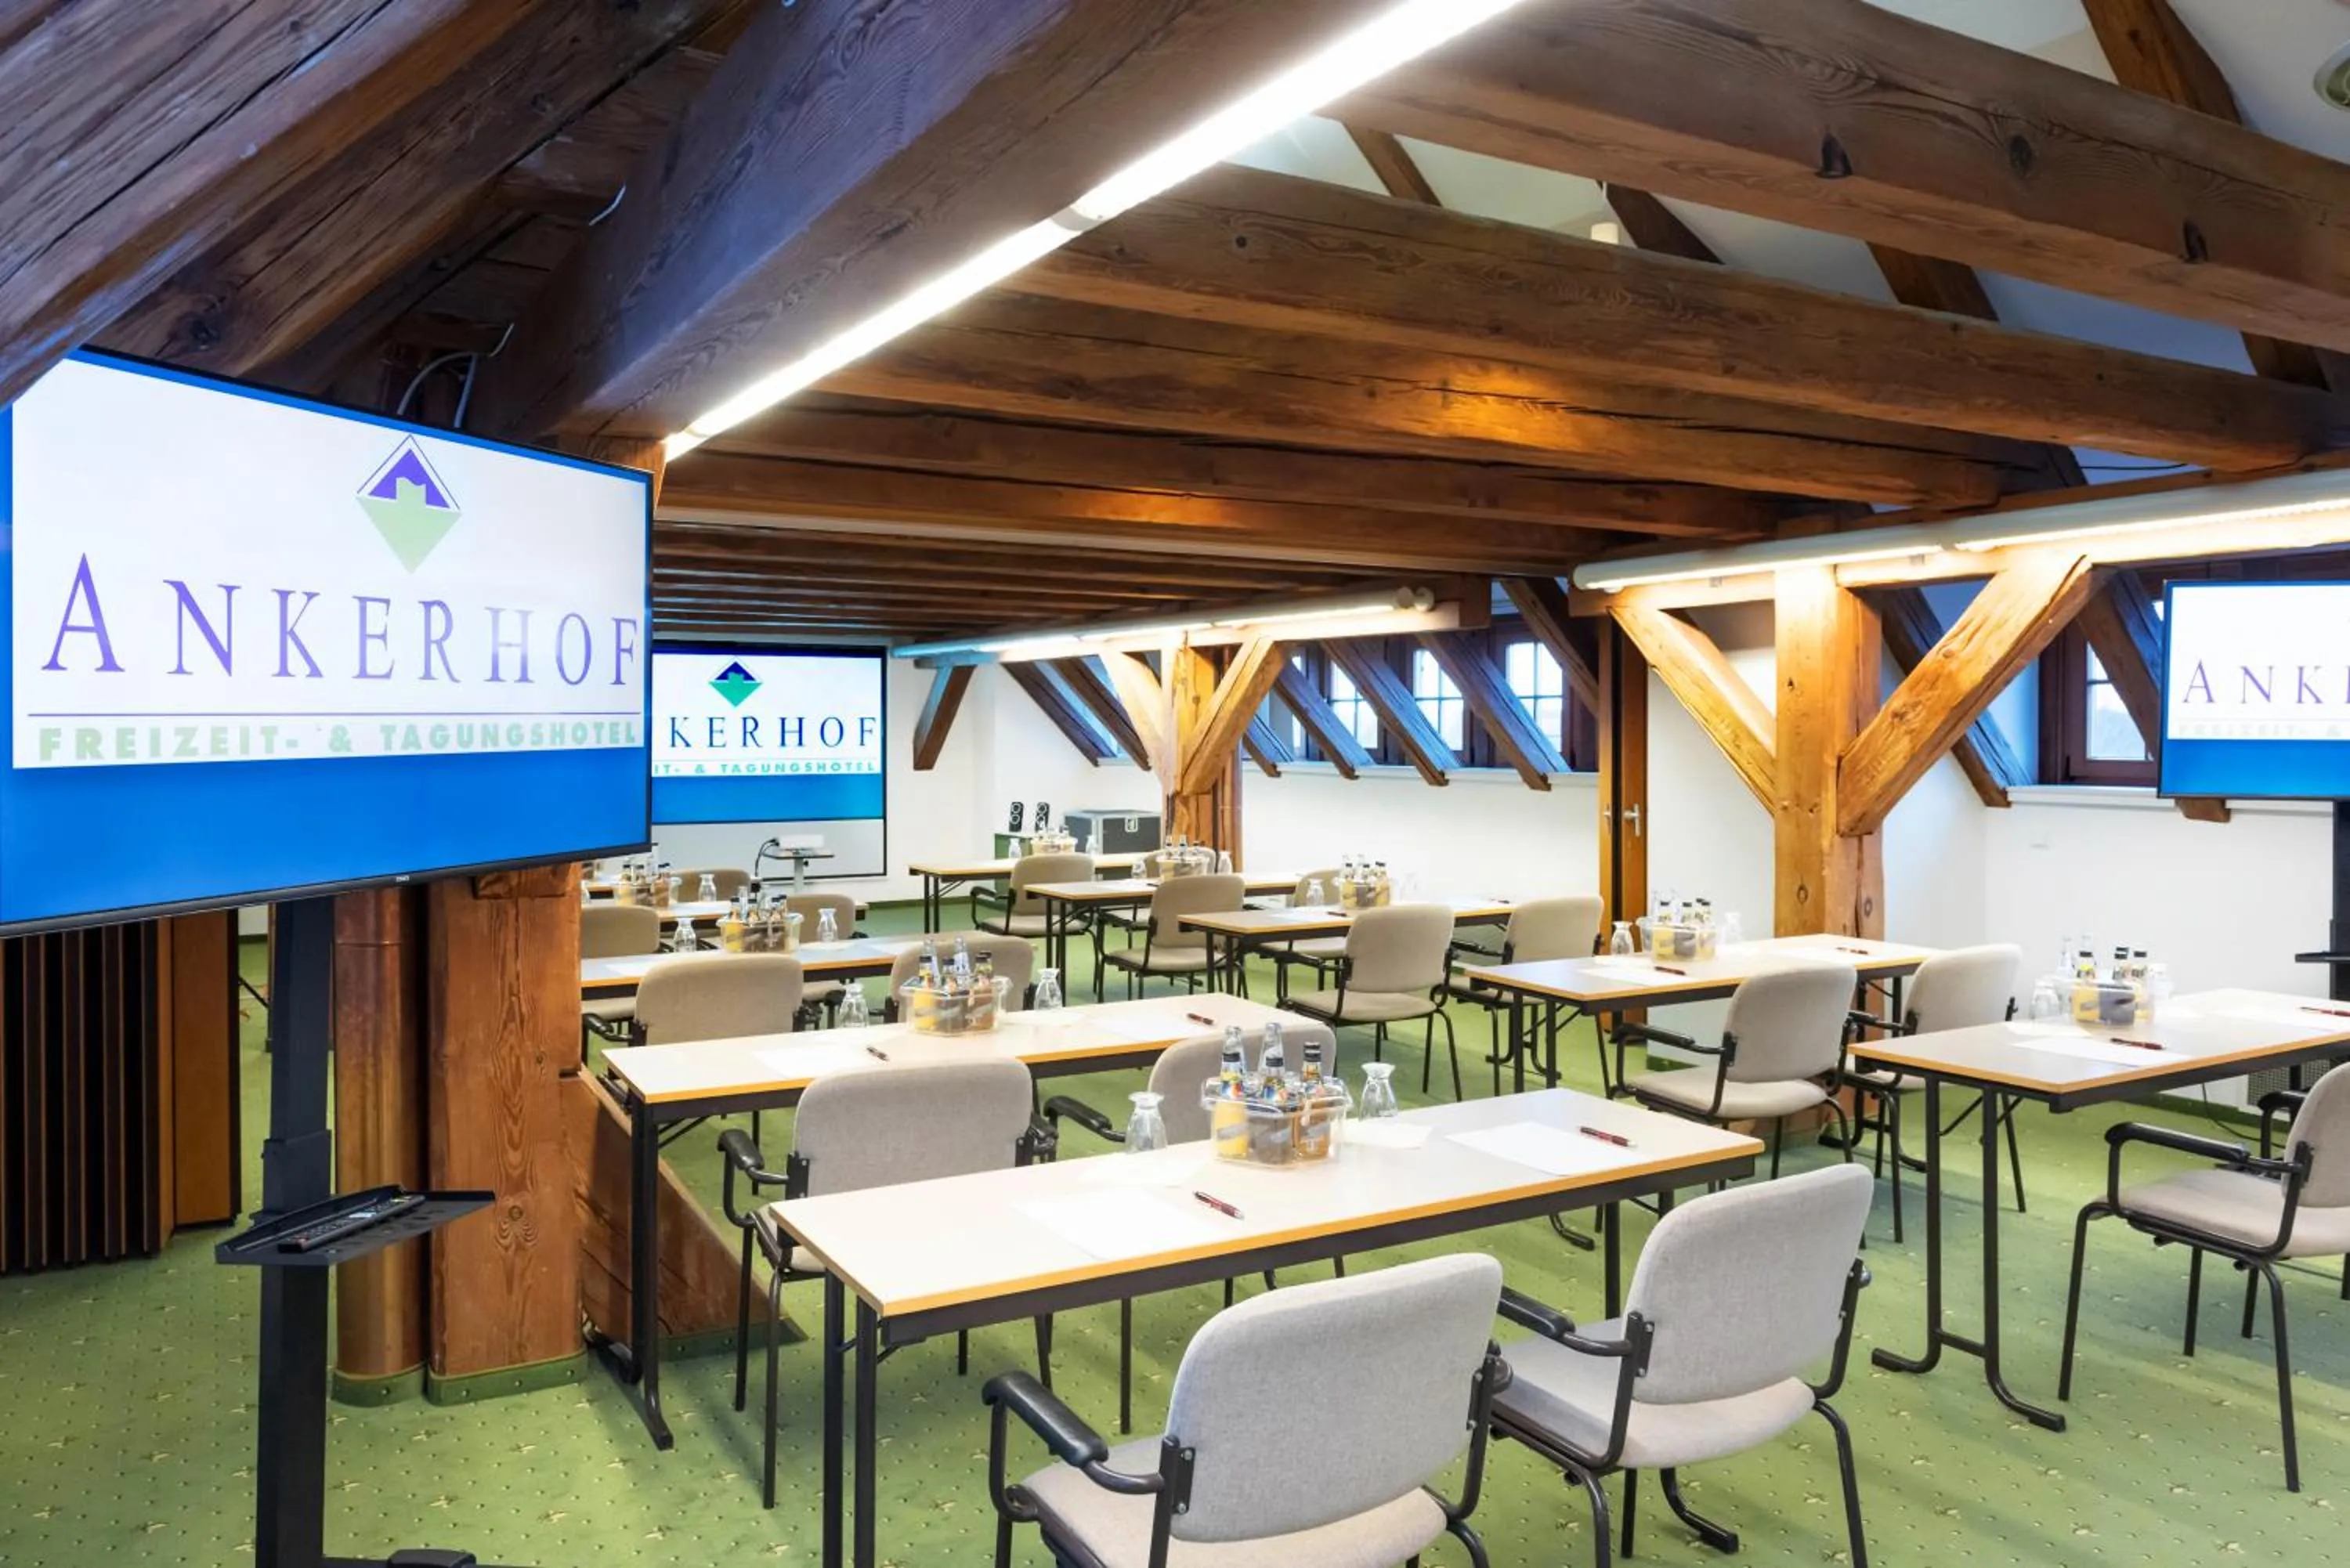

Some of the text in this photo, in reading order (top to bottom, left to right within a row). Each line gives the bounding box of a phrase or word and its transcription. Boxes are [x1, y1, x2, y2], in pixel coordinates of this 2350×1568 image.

[41, 551, 638, 686] ANKERHOF
[2182, 659, 2350, 704] ANK
[38, 722, 637, 762] FREIZEIT- & TAGUNGSHOTEL
[669, 716, 877, 748] KERHOF
[721, 761, 875, 774] TAGUNGSHOTEL
